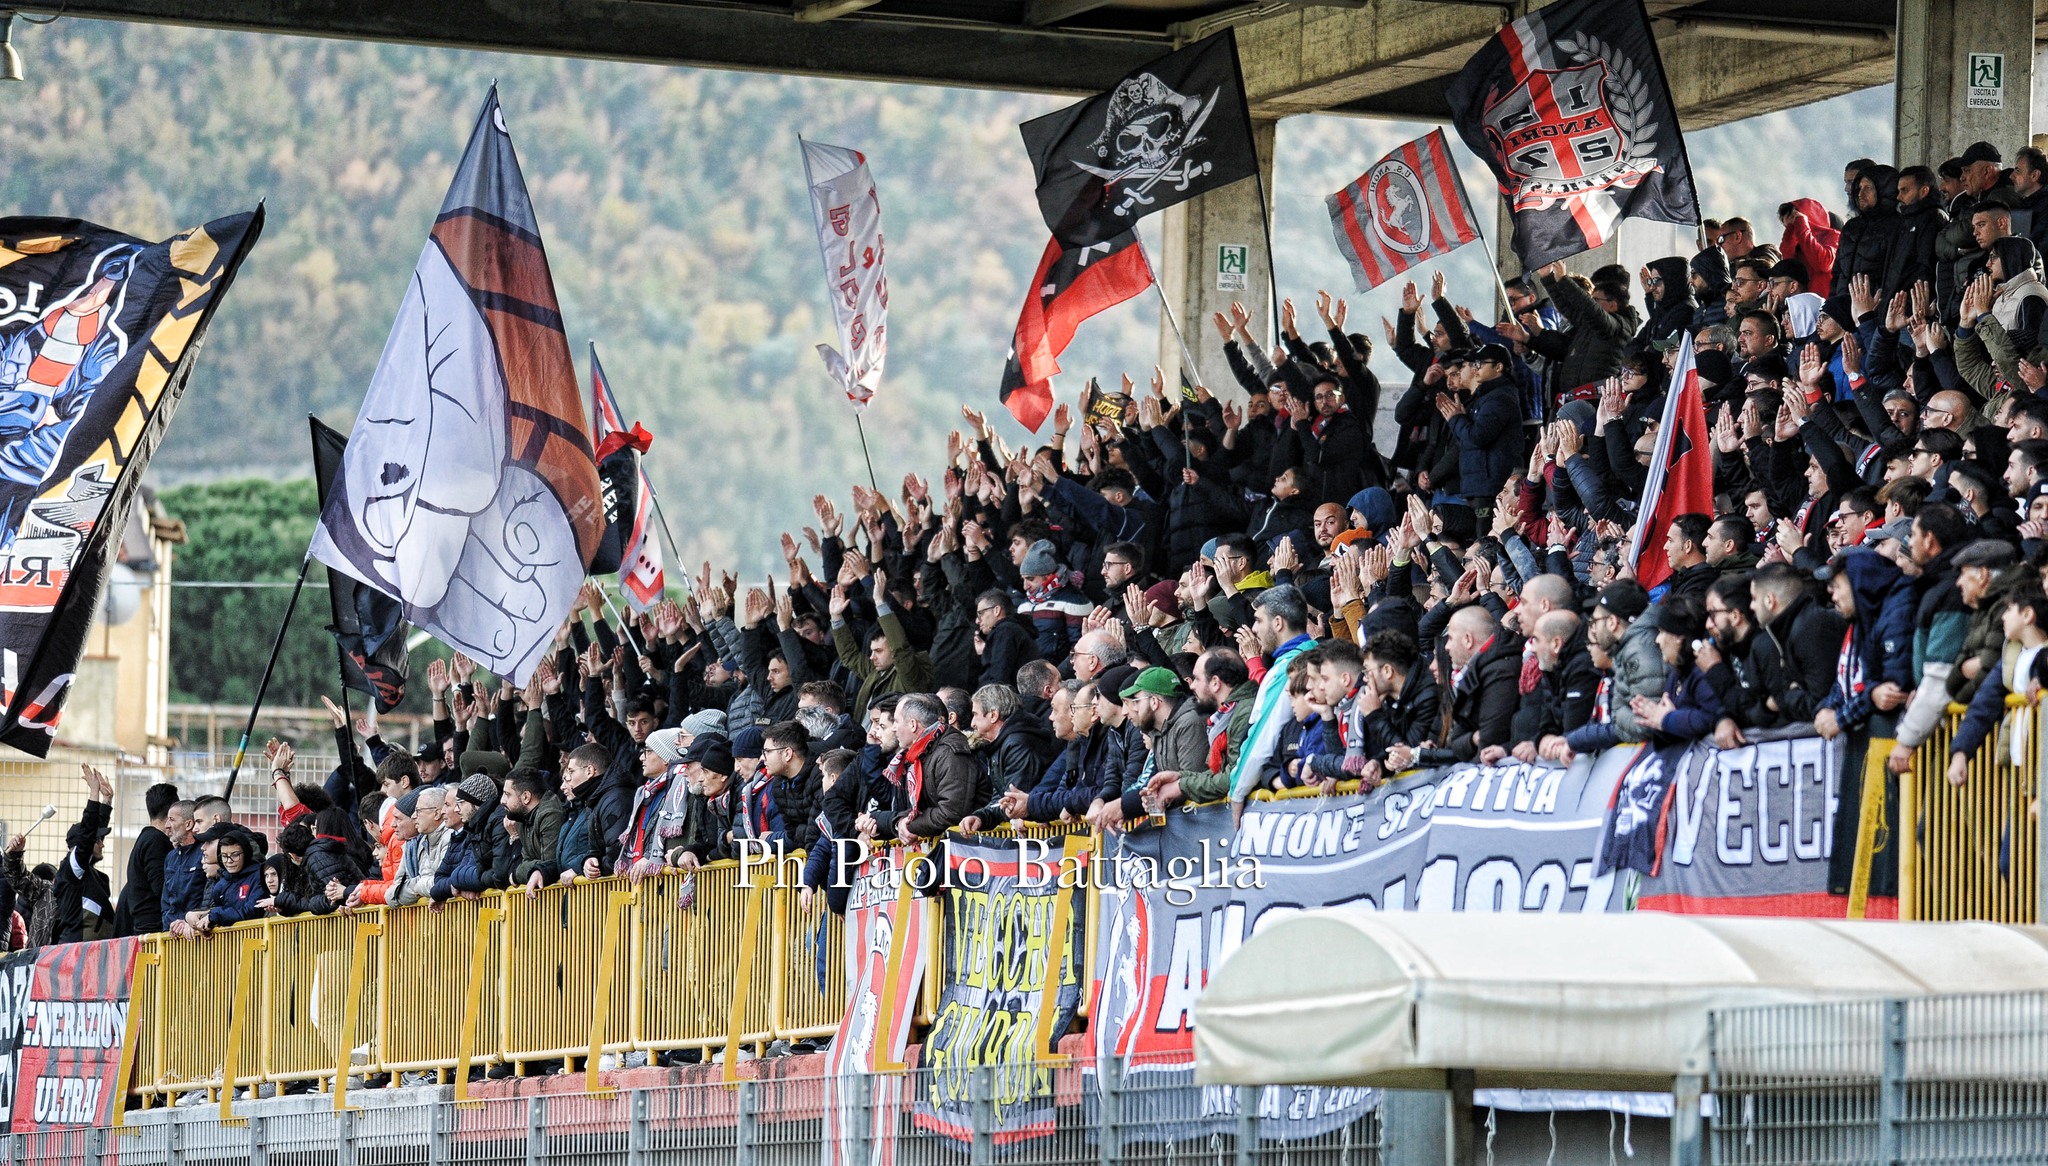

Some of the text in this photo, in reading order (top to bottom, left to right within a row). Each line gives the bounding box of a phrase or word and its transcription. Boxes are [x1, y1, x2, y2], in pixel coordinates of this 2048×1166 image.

[1973, 88, 1991, 97] USCITA
[1969, 98, 2001, 107] EMERGENZA
[22, 1000, 130, 1050] ENERAZION
